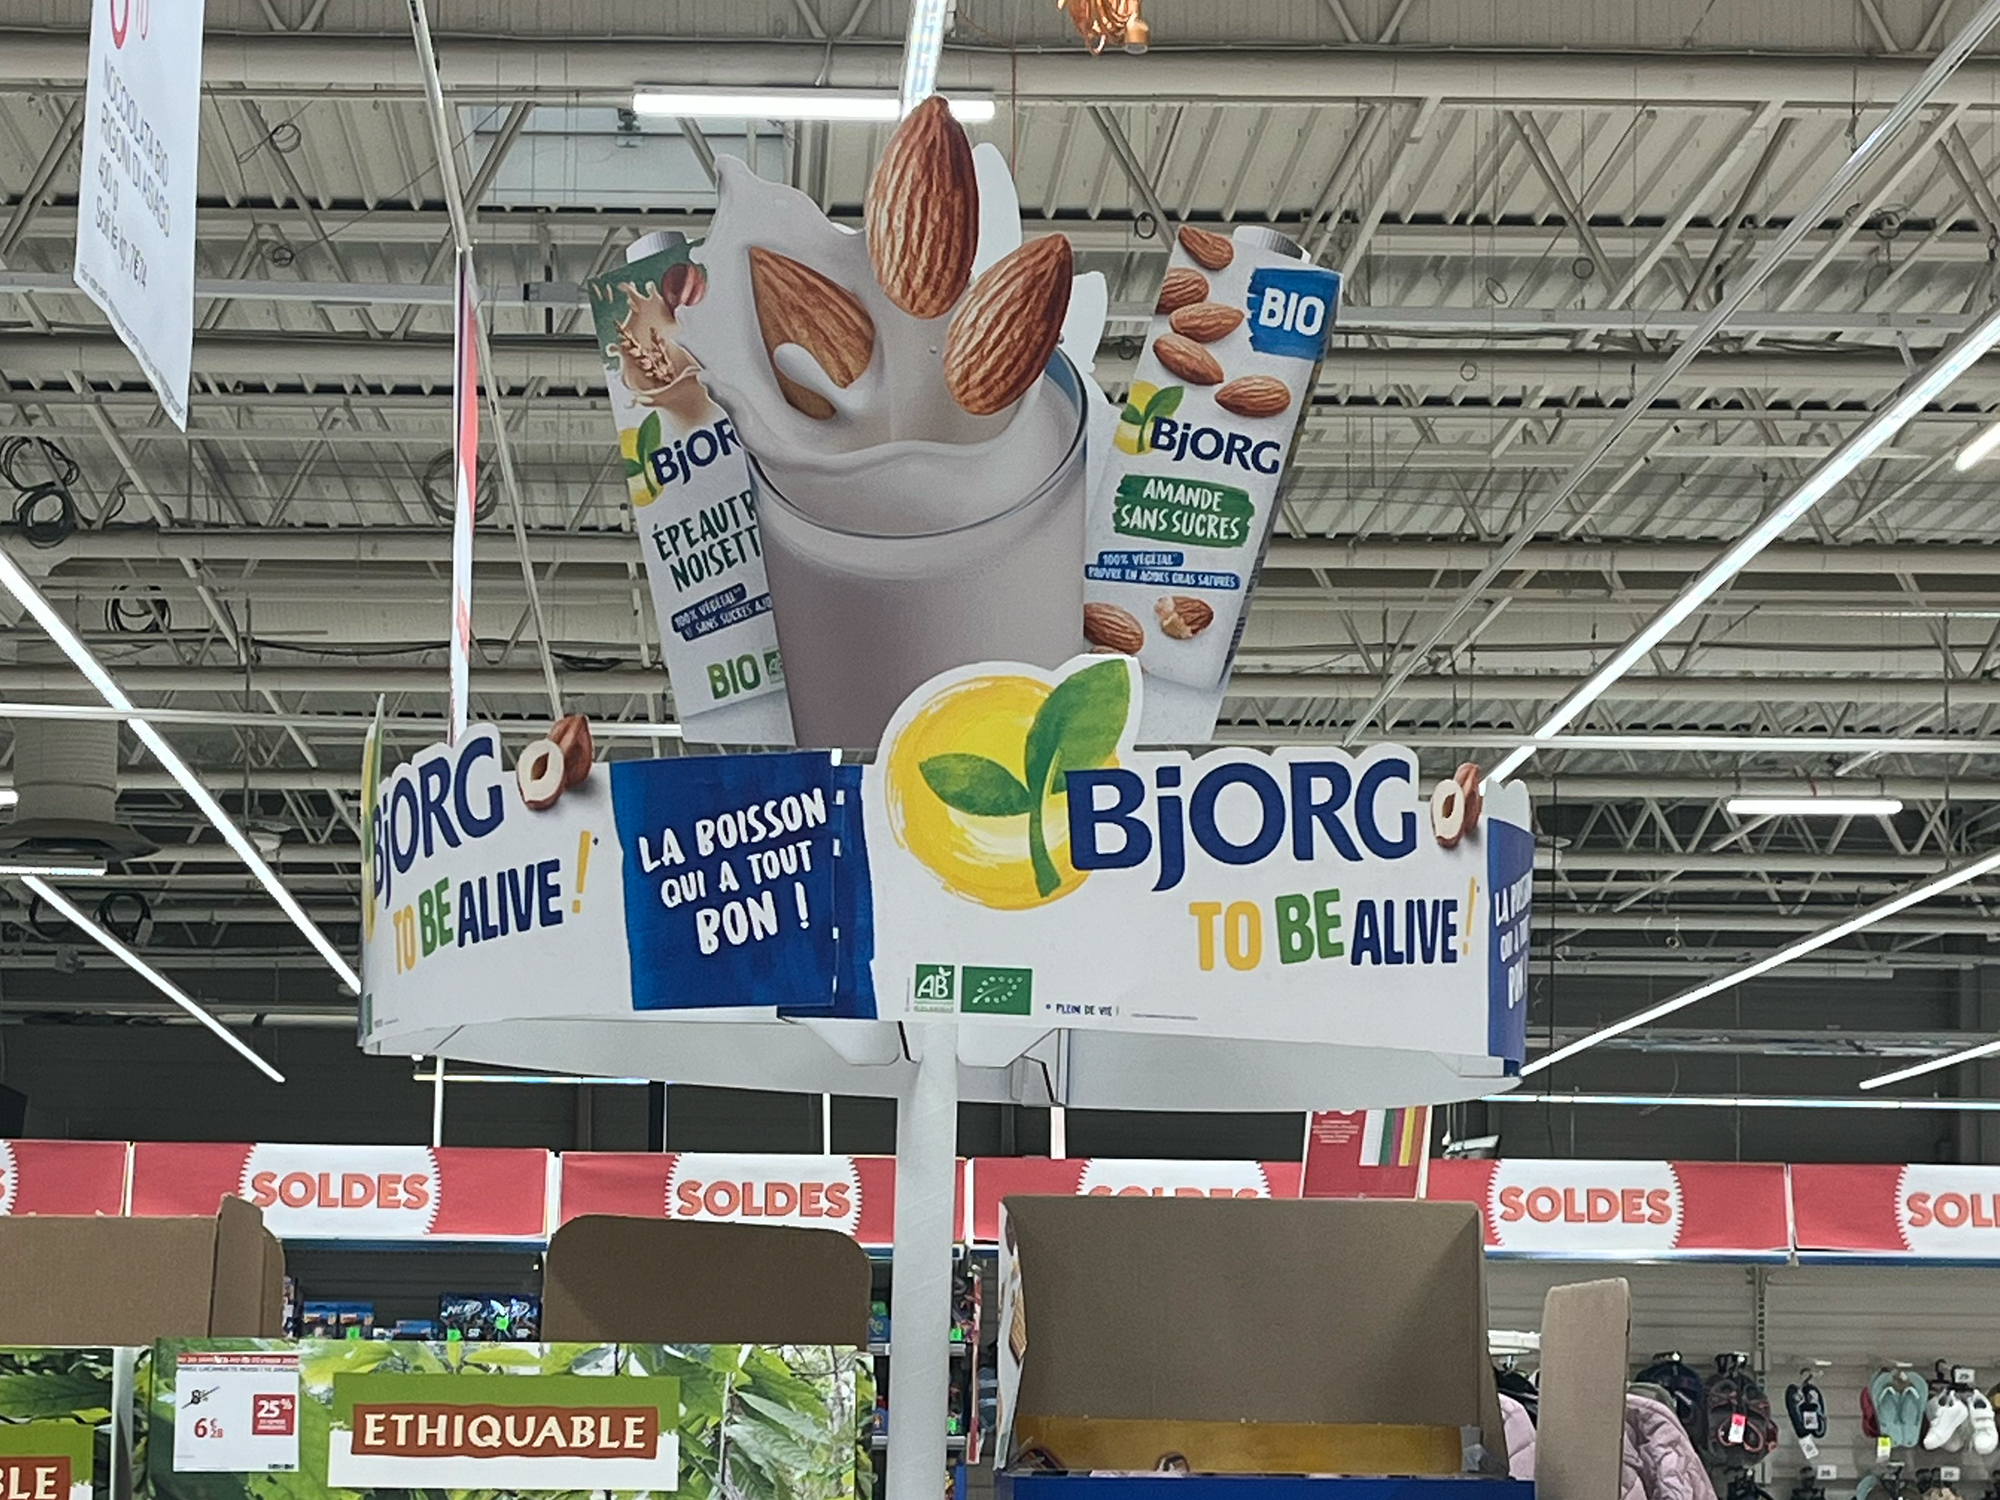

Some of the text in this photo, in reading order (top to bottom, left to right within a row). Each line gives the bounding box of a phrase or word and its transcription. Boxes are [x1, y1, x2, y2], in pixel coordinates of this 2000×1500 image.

[1259, 286, 1326, 337] BIO
[1142, 478, 1224, 512] AMANDE
[1120, 504, 1240, 541] SANS SUCRES
[670, 525, 760, 593] NOISETT
[706, 654, 761, 699] BIO
[639, 787, 827, 874] LA BOISSON
[1064, 758, 1418, 892] BjORG
[661, 840, 813, 909] QUI A TOUT
[393, 904, 416, 975] TO
[418, 877, 454, 958] BE
[696, 891, 779, 955] BON
[1189, 900, 1262, 972] TO
[1275, 889, 1345, 966] BE
[917, 973, 949, 999] AB
[1084, 1005, 1094, 1015] DE
[251, 1171, 430, 1210] SOLDES
[676, 1179, 852, 1218] SOLDES
[1499, 1185, 1673, 1224] SOLDES
[1906, 1191, 2000, 1229] SOL
[363, 1412, 646, 1450] ETHIQUABLE
[0, 1466, 58, 1500] LE
